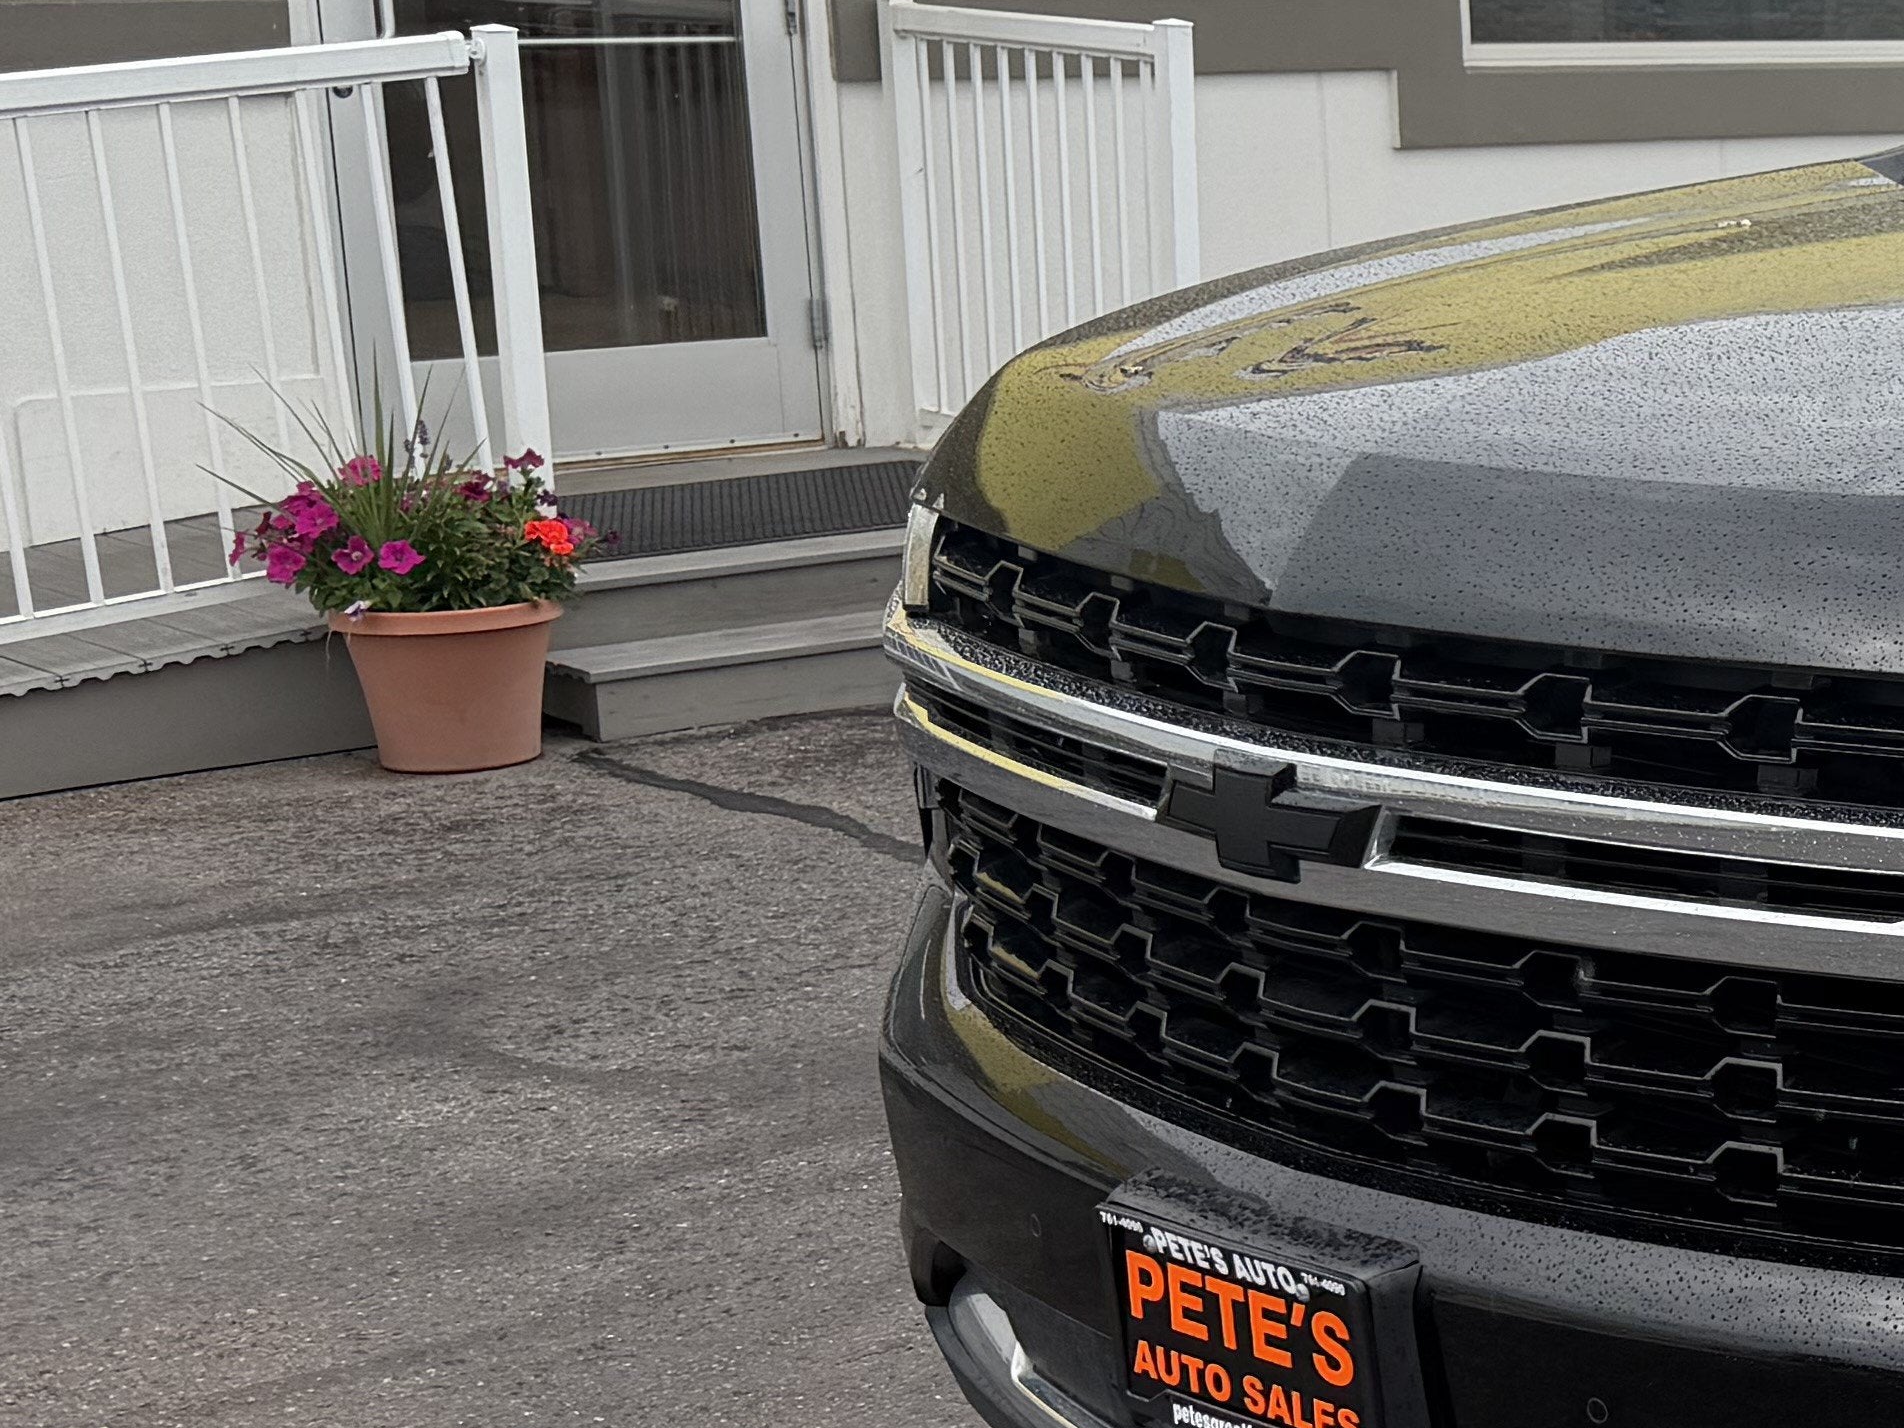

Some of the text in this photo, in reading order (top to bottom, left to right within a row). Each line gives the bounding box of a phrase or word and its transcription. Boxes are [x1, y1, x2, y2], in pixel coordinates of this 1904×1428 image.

[1150, 1227, 1229, 1275] PETE'S
[1232, 1254, 1297, 1295] AUTO
[1125, 1249, 1354, 1387] PETE'S
[1133, 1339, 1232, 1402] AUTO
